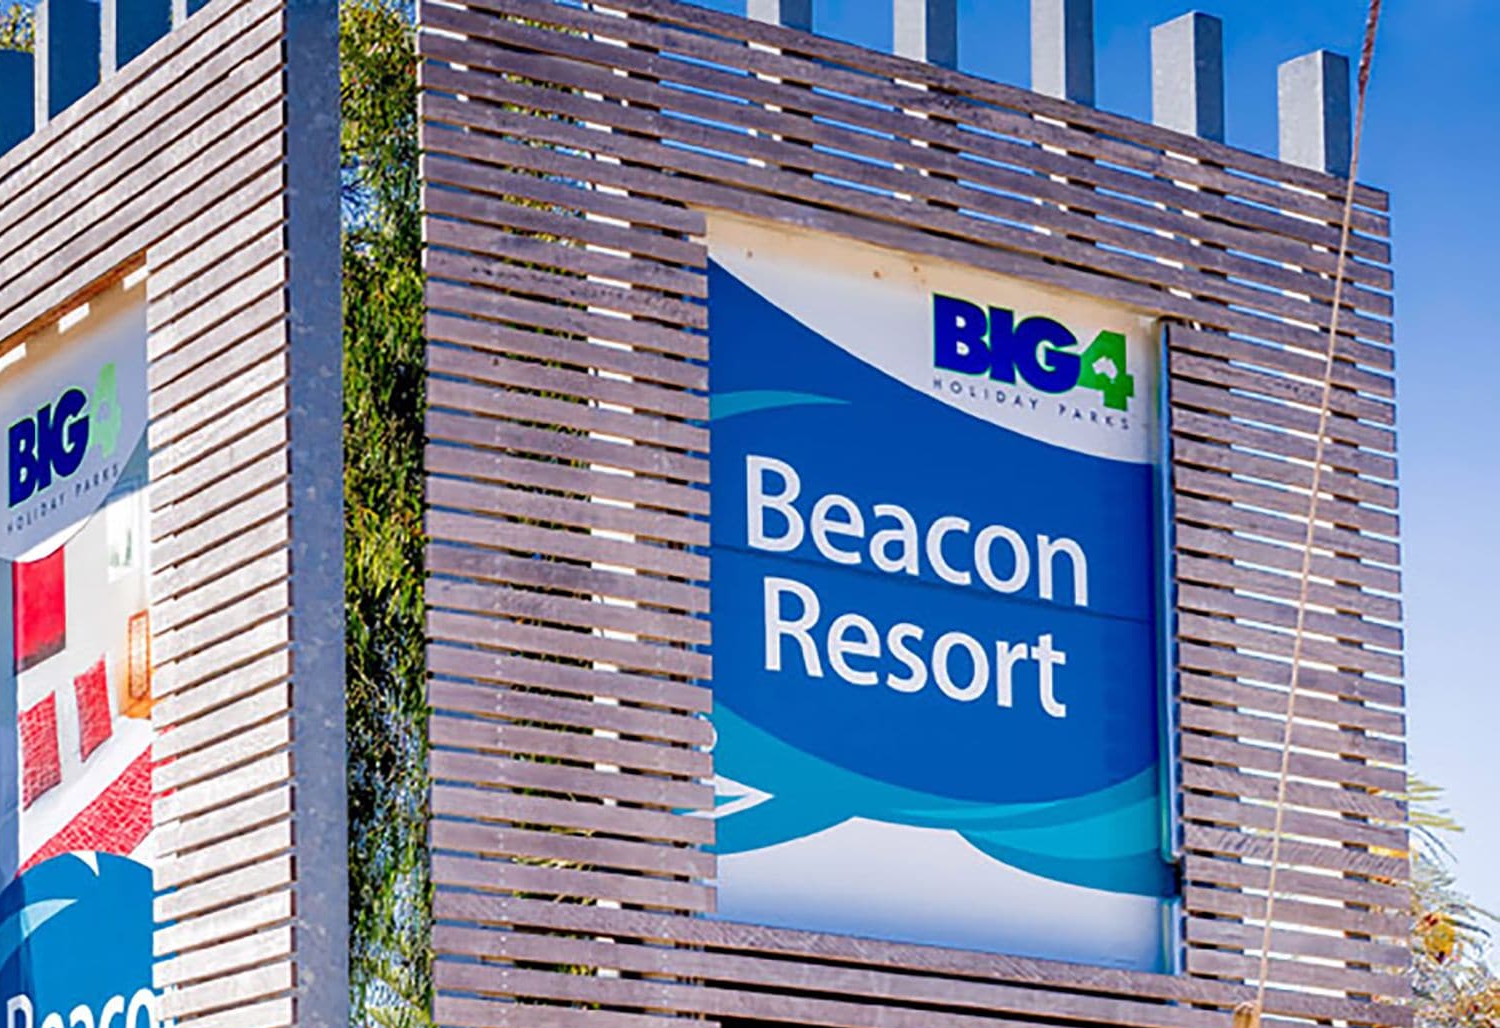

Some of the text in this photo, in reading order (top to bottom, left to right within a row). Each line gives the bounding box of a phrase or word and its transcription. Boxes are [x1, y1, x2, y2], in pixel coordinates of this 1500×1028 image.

[932, 293, 1134, 411] BIG4
[932, 379, 1131, 430] HOLIDAY PARKS
[7, 464, 118, 533] HOLIDAY PARKS
[8, 362, 121, 507] BIG4
[745, 454, 1089, 607] Beacon
[763, 575, 1067, 718] Resort
